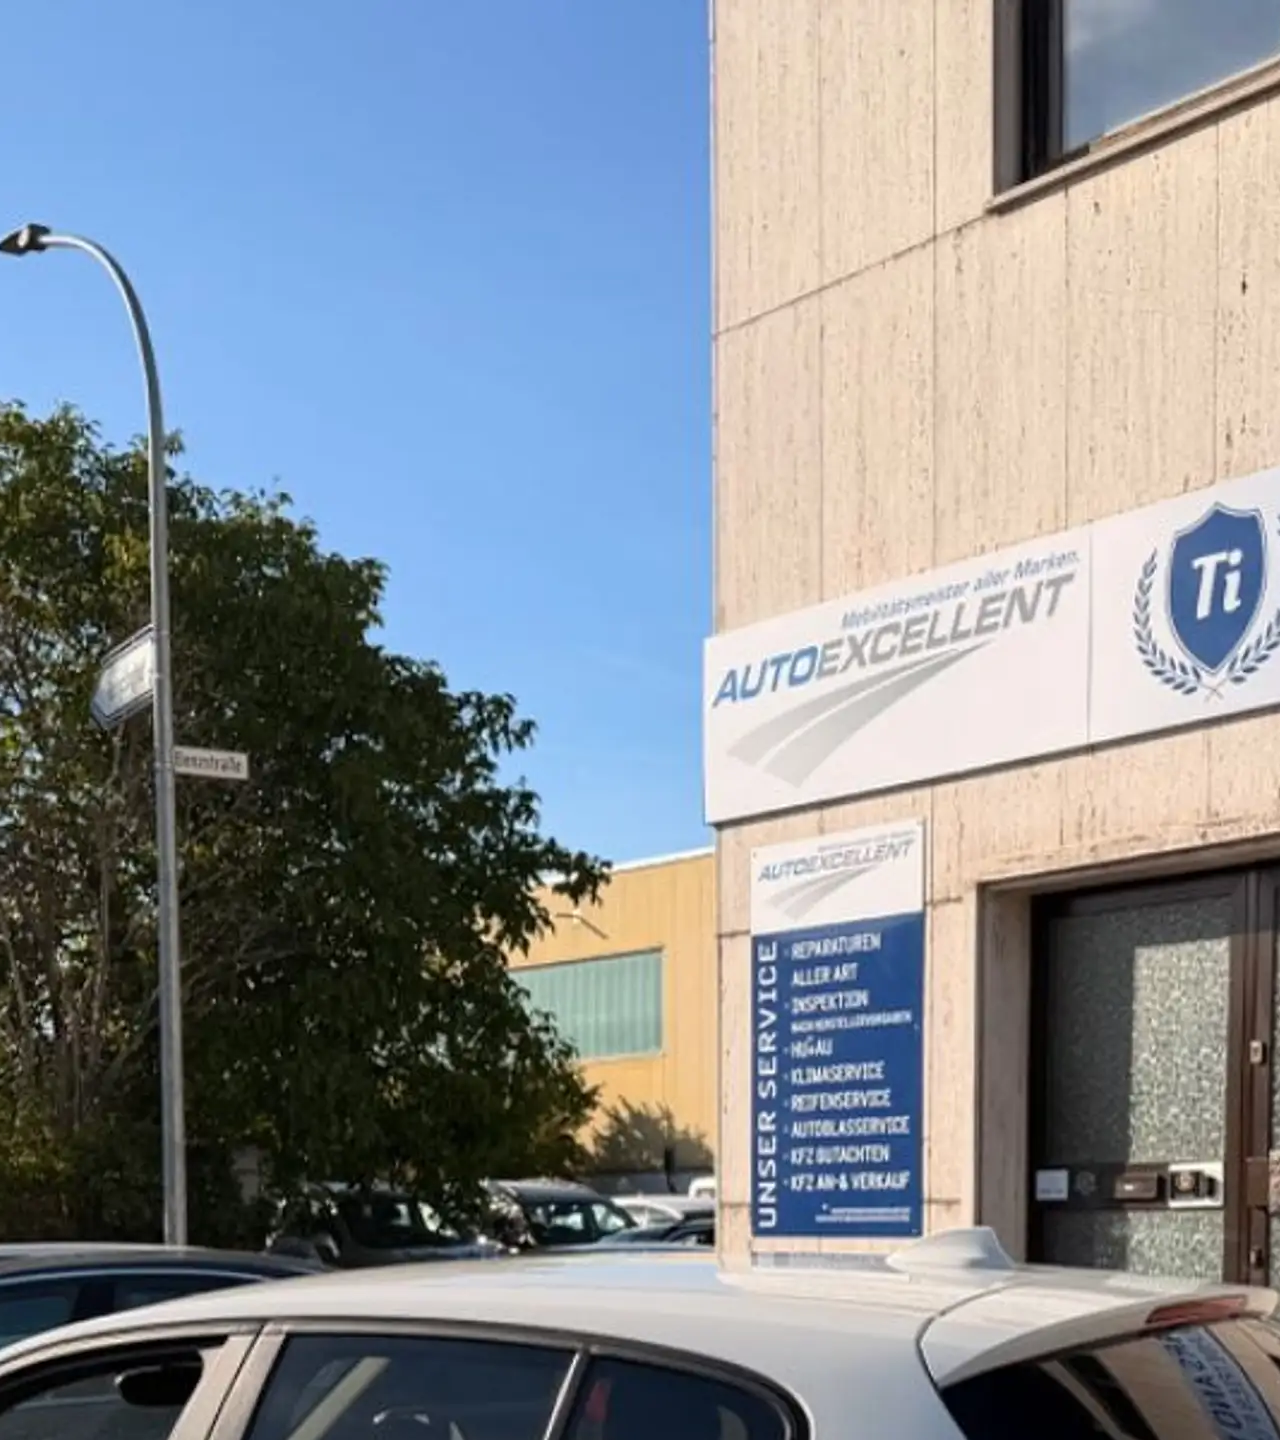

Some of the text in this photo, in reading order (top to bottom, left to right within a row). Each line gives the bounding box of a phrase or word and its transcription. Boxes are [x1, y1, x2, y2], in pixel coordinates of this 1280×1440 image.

[1191, 547, 1244, 620] Ti
[712, 573, 1074, 708] AUTOEXCELLENT
[758, 838, 916, 883] AUTOEXCELLENT
[791, 932, 882, 960] REPARATUREN
[791, 962, 859, 986] ALLER ART
[791, 990, 869, 1014] INSPEKTION
[757, 941, 778, 1228] UNSER SERVICE
[791, 1061, 886, 1085] KLIMASERVICE
[791, 1088, 891, 1112] REIFENSERVICE
[791, 1147, 814, 1165] KFZ
[791, 1174, 814, 1192] KFZ
